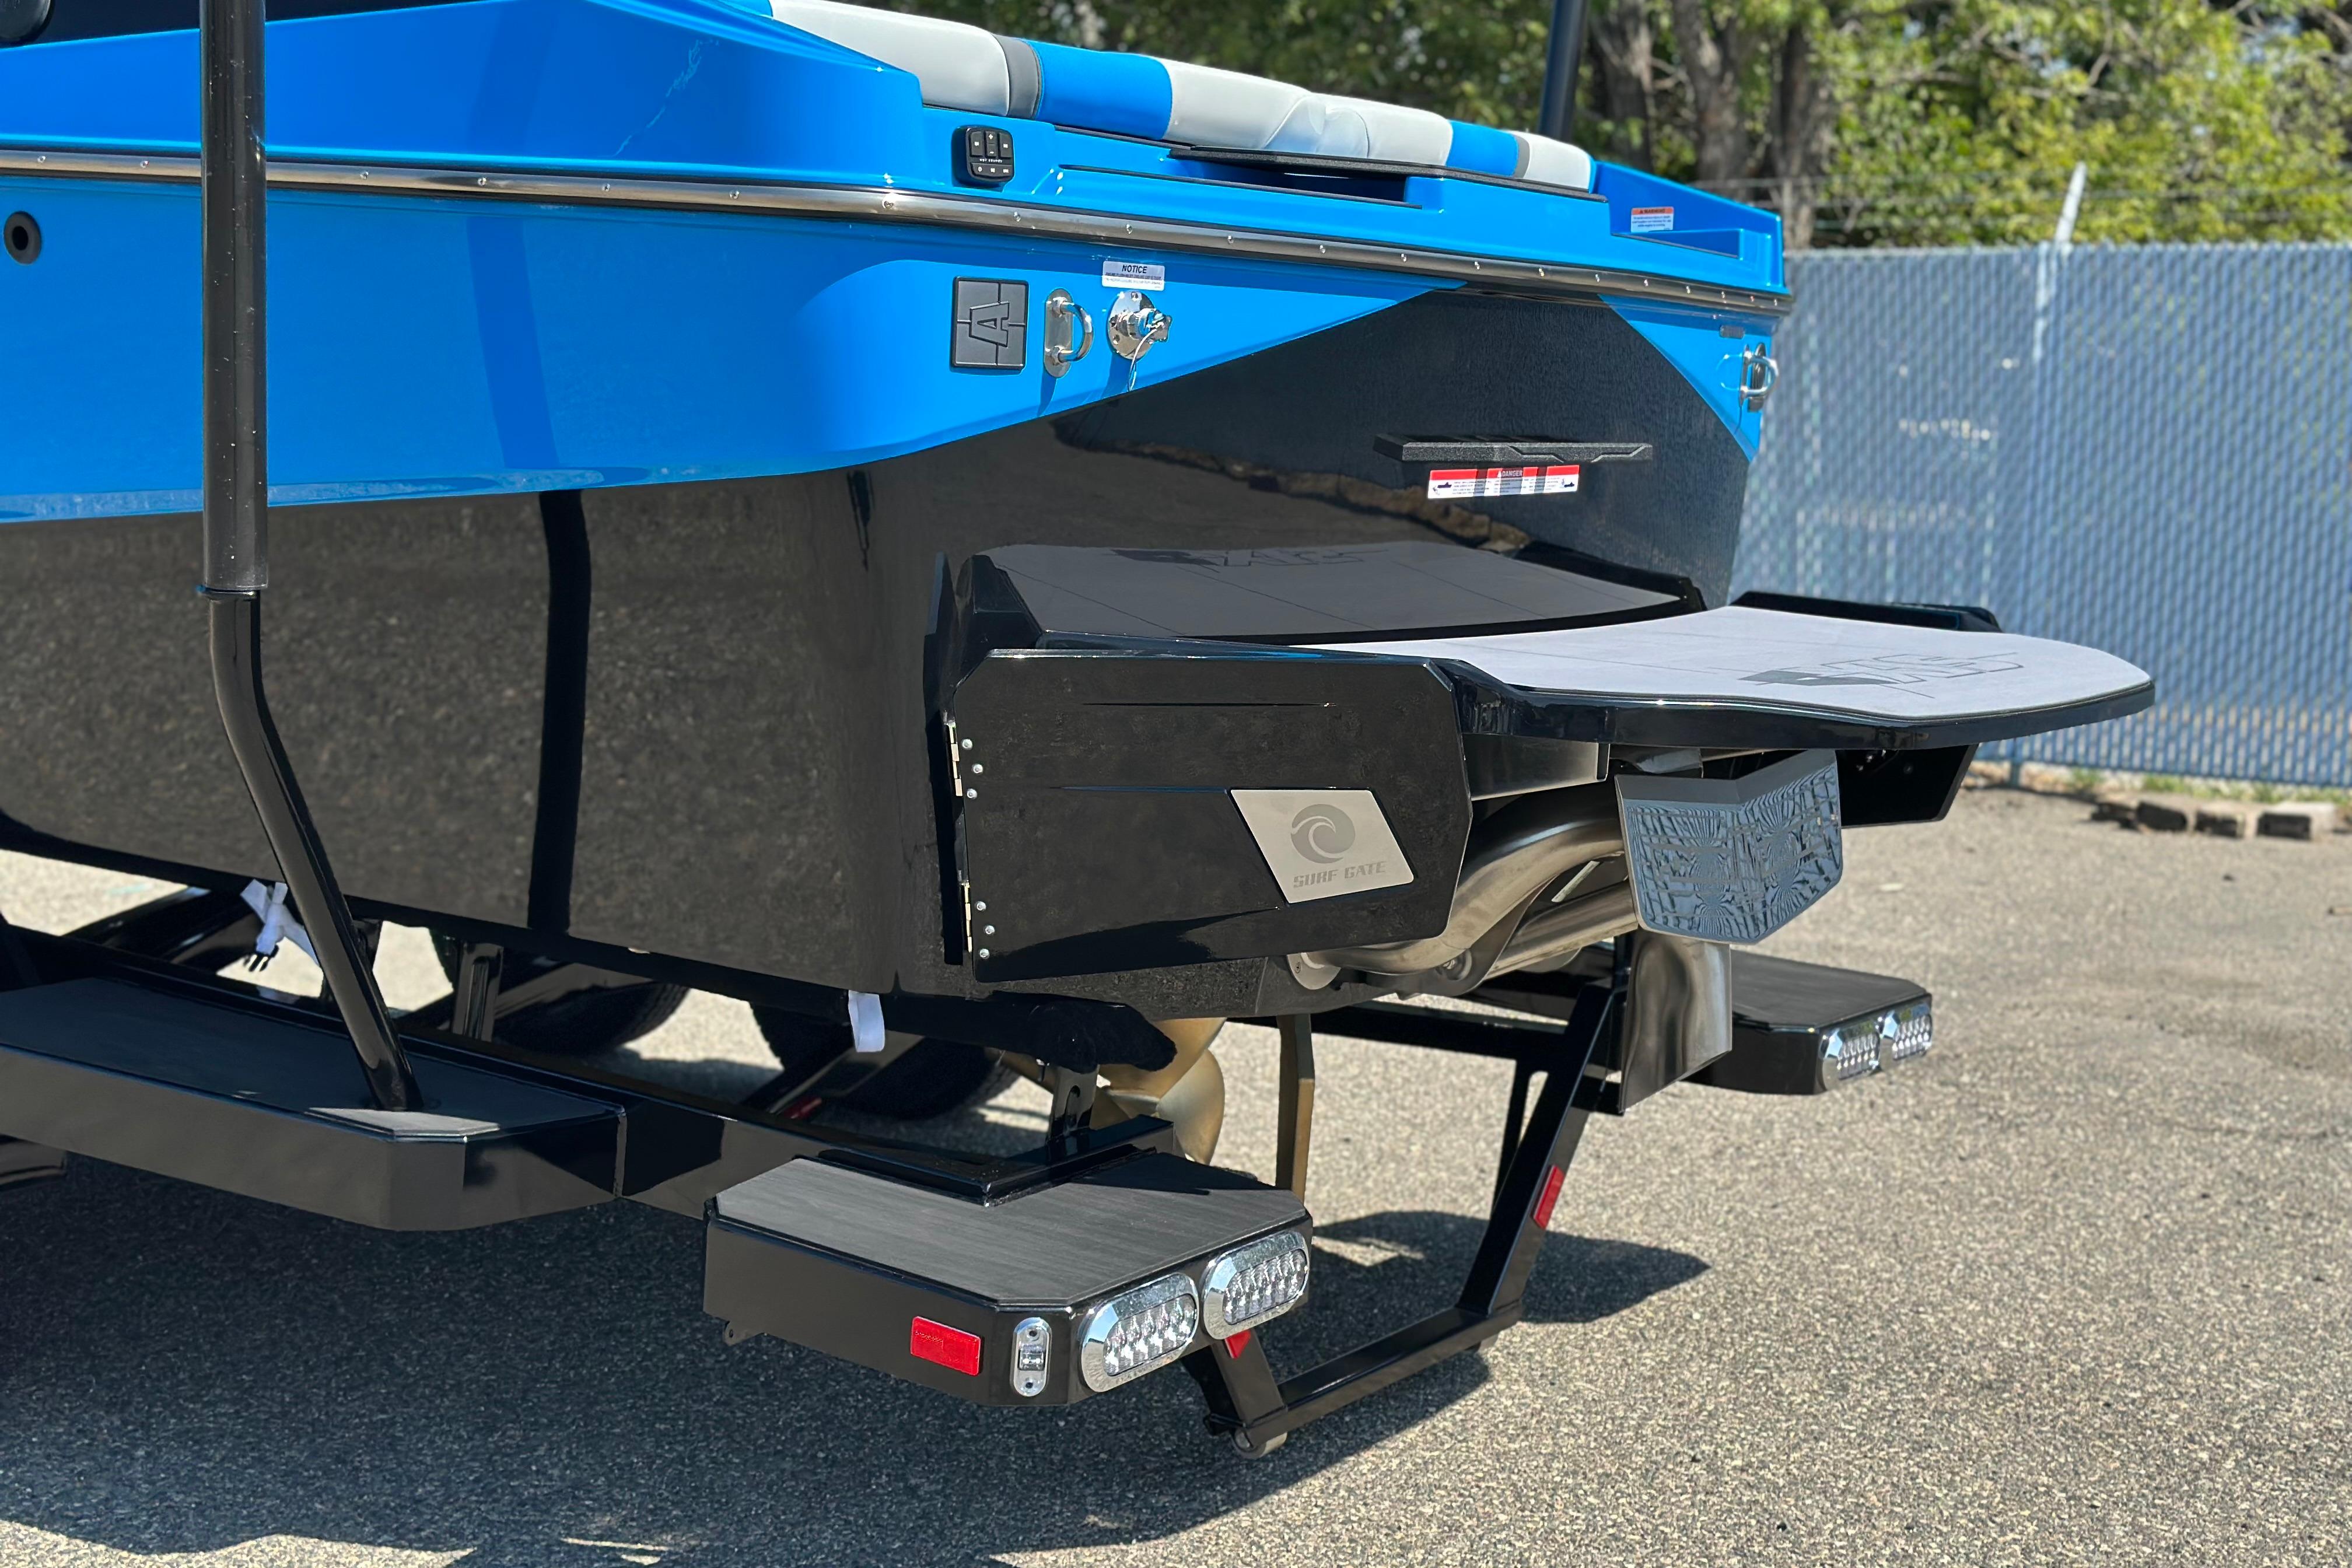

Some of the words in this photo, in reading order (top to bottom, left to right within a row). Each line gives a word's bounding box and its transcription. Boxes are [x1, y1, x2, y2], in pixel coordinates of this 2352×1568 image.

[1122, 264, 1148, 274] NOTICE
[1293, 869, 1339, 888] SURF
[1344, 860, 1388, 880] GATE
